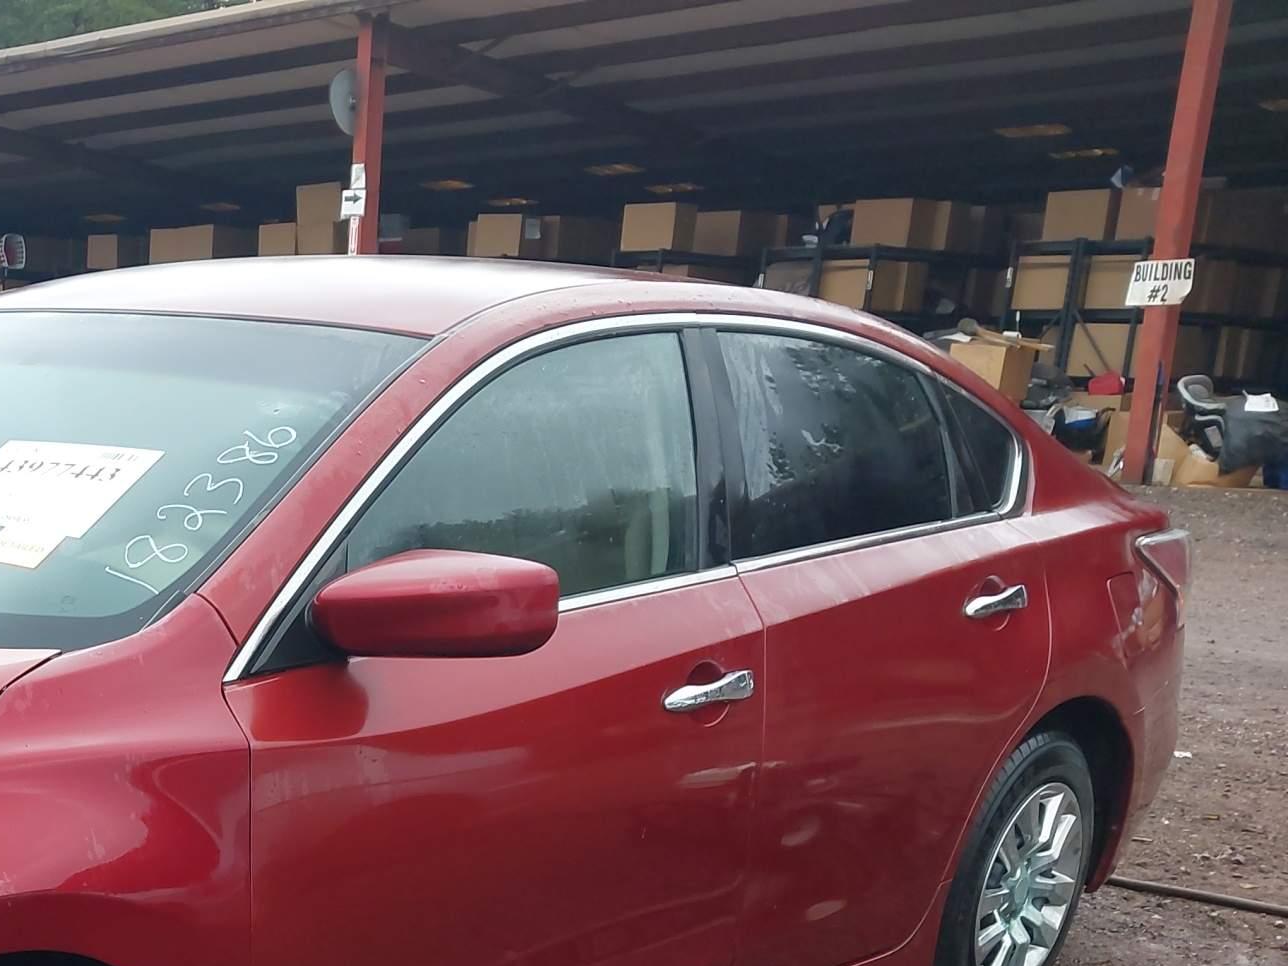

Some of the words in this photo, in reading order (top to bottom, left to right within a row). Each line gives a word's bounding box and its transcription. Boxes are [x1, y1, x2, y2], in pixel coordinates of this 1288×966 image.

[1134, 261, 1193, 282] BUILDING
[1147, 284, 1169, 303] #2
[105, 426, 297, 594] 182386
